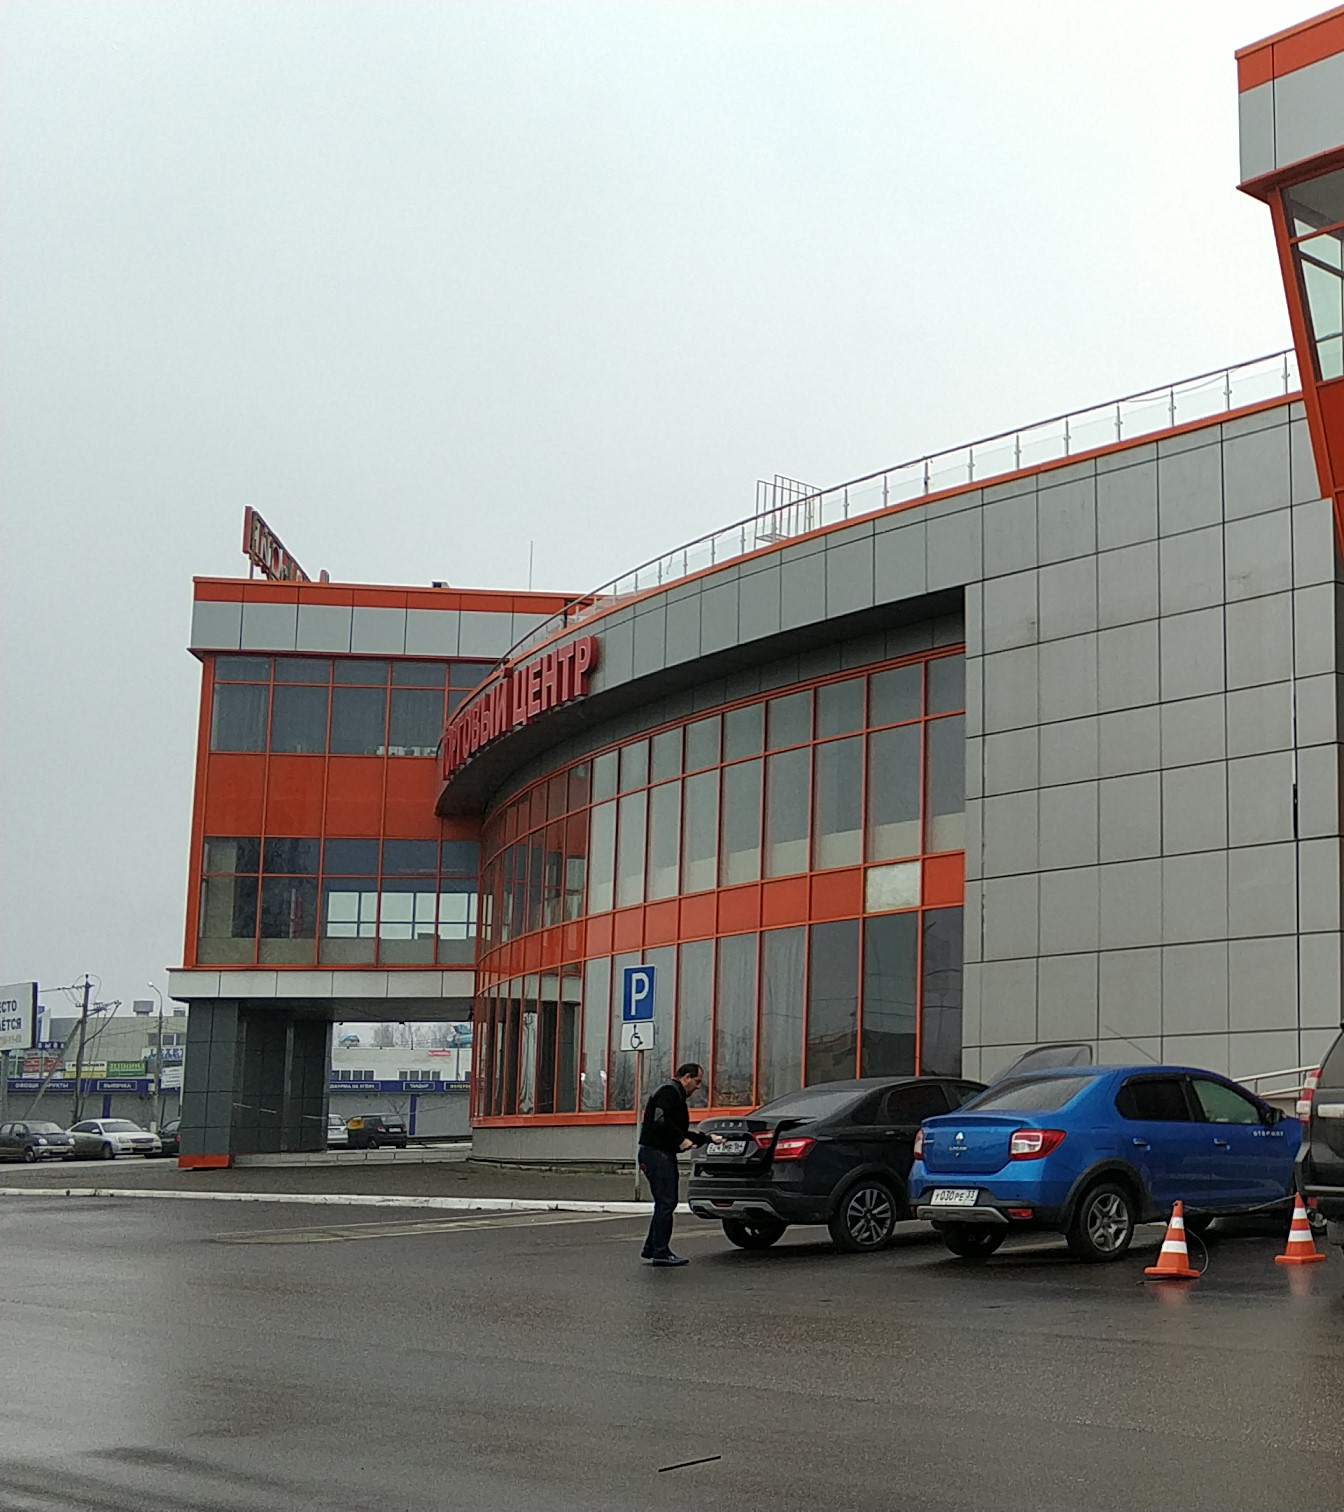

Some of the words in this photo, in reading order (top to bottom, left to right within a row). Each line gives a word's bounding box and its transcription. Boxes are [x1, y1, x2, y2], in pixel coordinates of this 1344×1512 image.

[512, 635, 598, 725] ЦЕНТР
[0, 999, 18, 1014] СТО
[630, 971, 650, 1016] P
